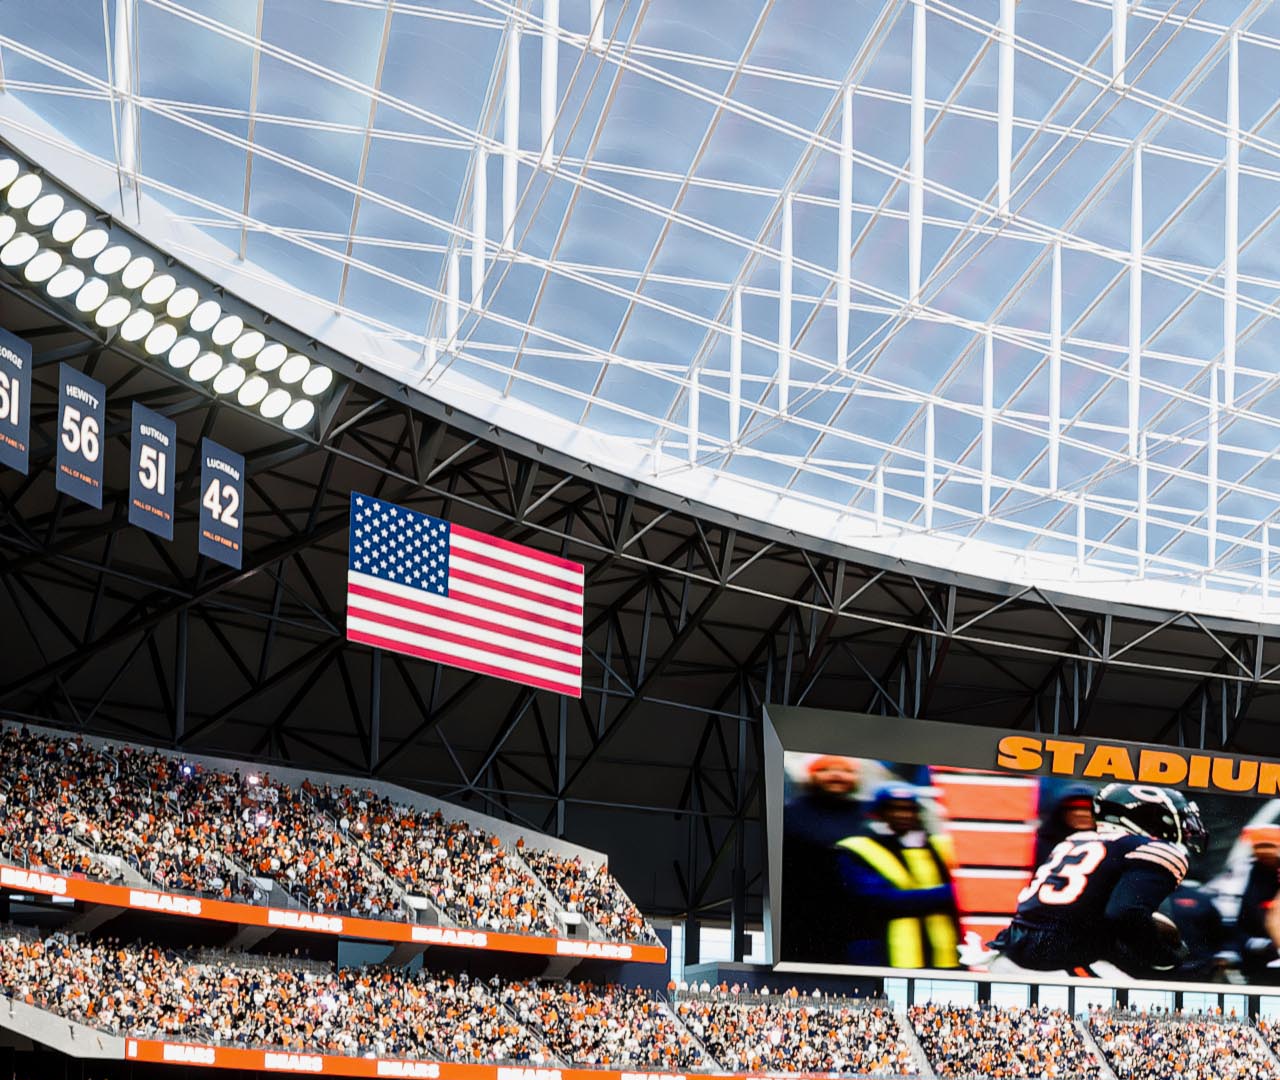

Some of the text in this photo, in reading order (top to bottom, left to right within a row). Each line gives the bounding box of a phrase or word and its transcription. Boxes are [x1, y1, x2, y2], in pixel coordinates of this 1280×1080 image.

[66, 384, 99, 409] HEWITT
[61, 404, 100, 463] 56
[138, 443, 166, 496] 51
[206, 456, 240, 481] LUCKMAN
[203, 478, 240, 529] 42
